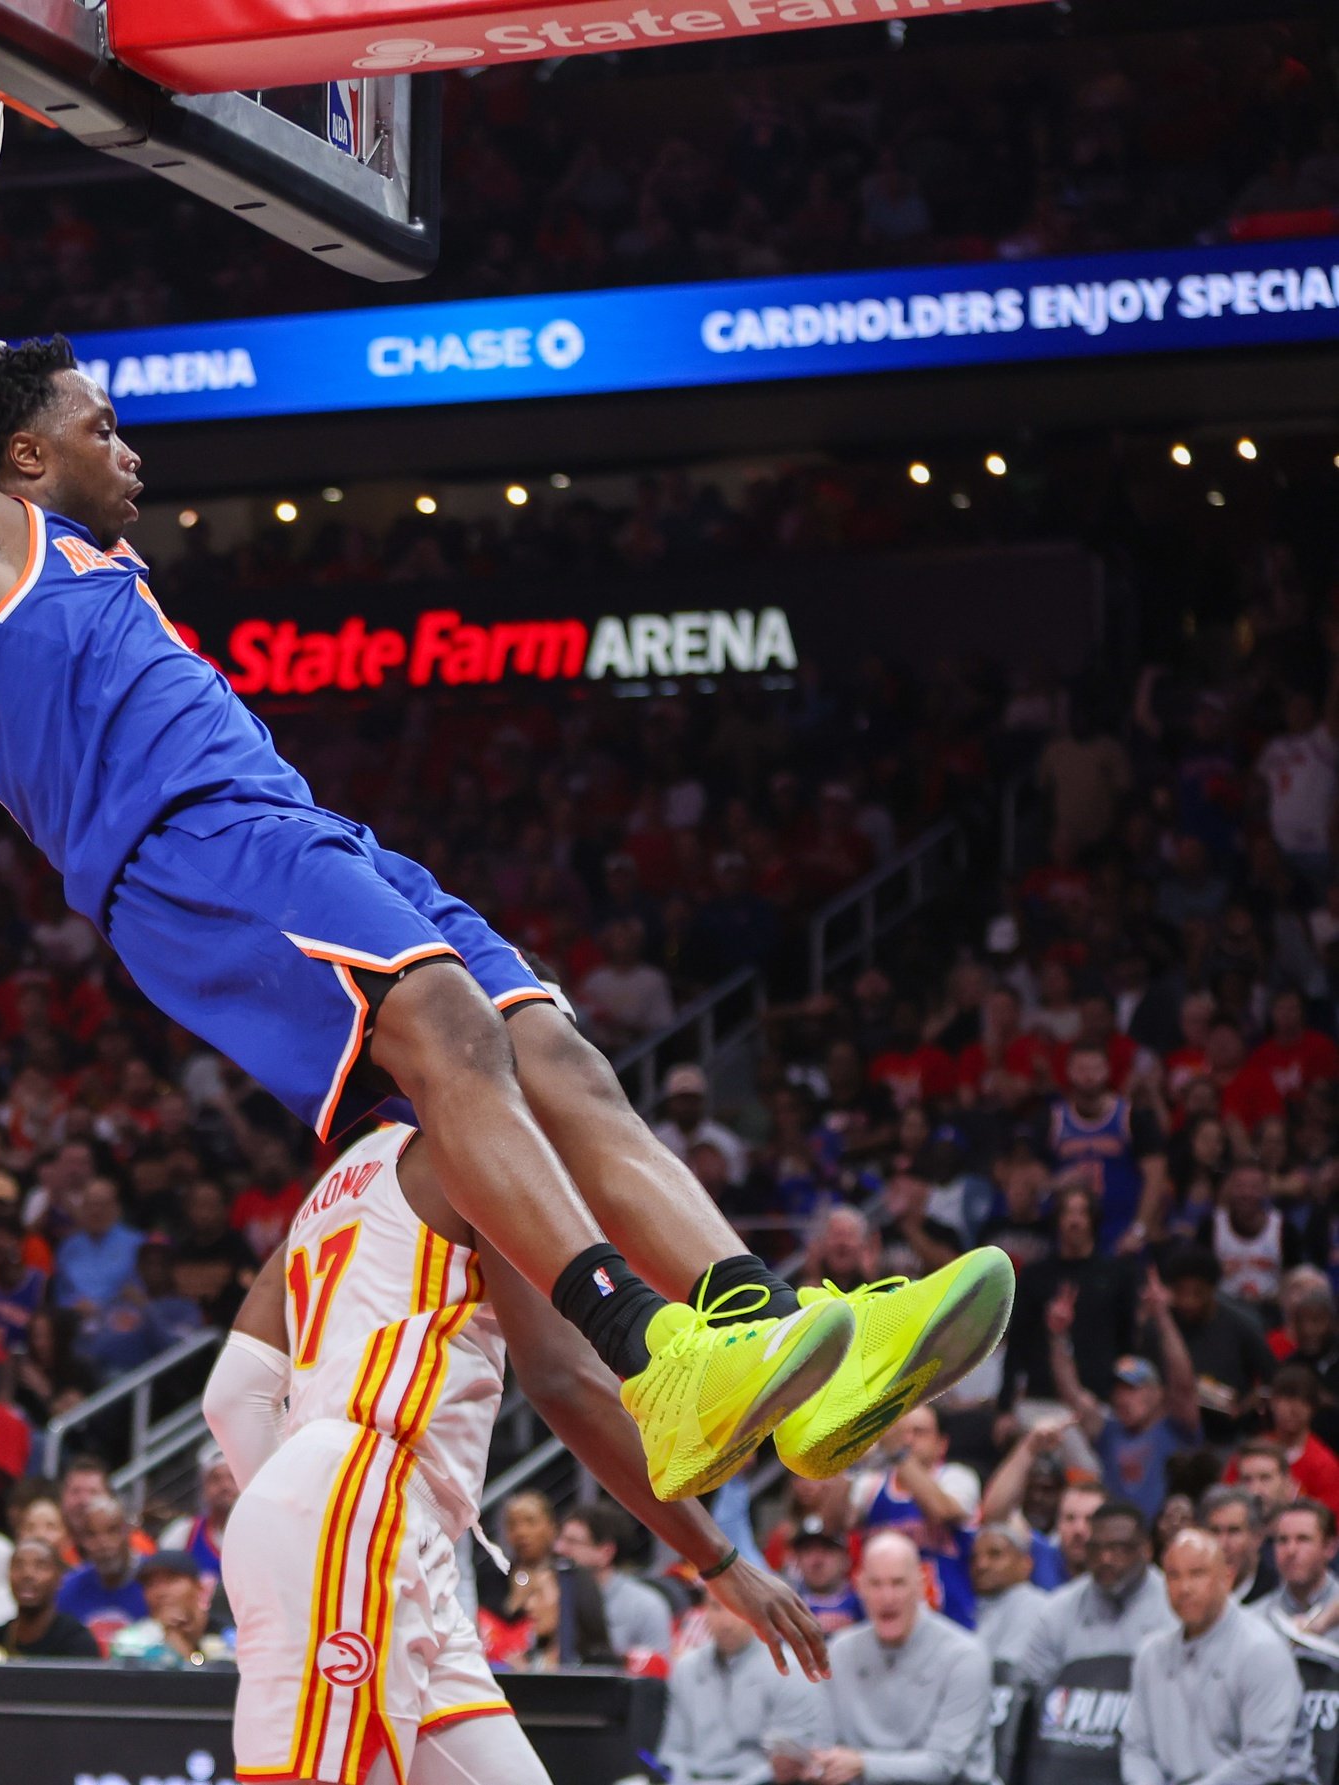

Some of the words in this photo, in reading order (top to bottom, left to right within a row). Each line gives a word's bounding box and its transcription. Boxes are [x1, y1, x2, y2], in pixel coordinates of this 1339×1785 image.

[484, 8, 725, 54] State
[332, 112, 349, 146] NBA
[701, 288, 1025, 353] CARDHOLDERS
[1029, 276, 1173, 336] ENJOY
[111, 347, 258, 398] ARENA
[367, 327, 533, 377] CHASE
[228, 615, 406, 695] State
[407, 609, 589, 686] Farm
[585, 607, 798, 681] ARENA
[286, 1219, 362, 1370] 17
